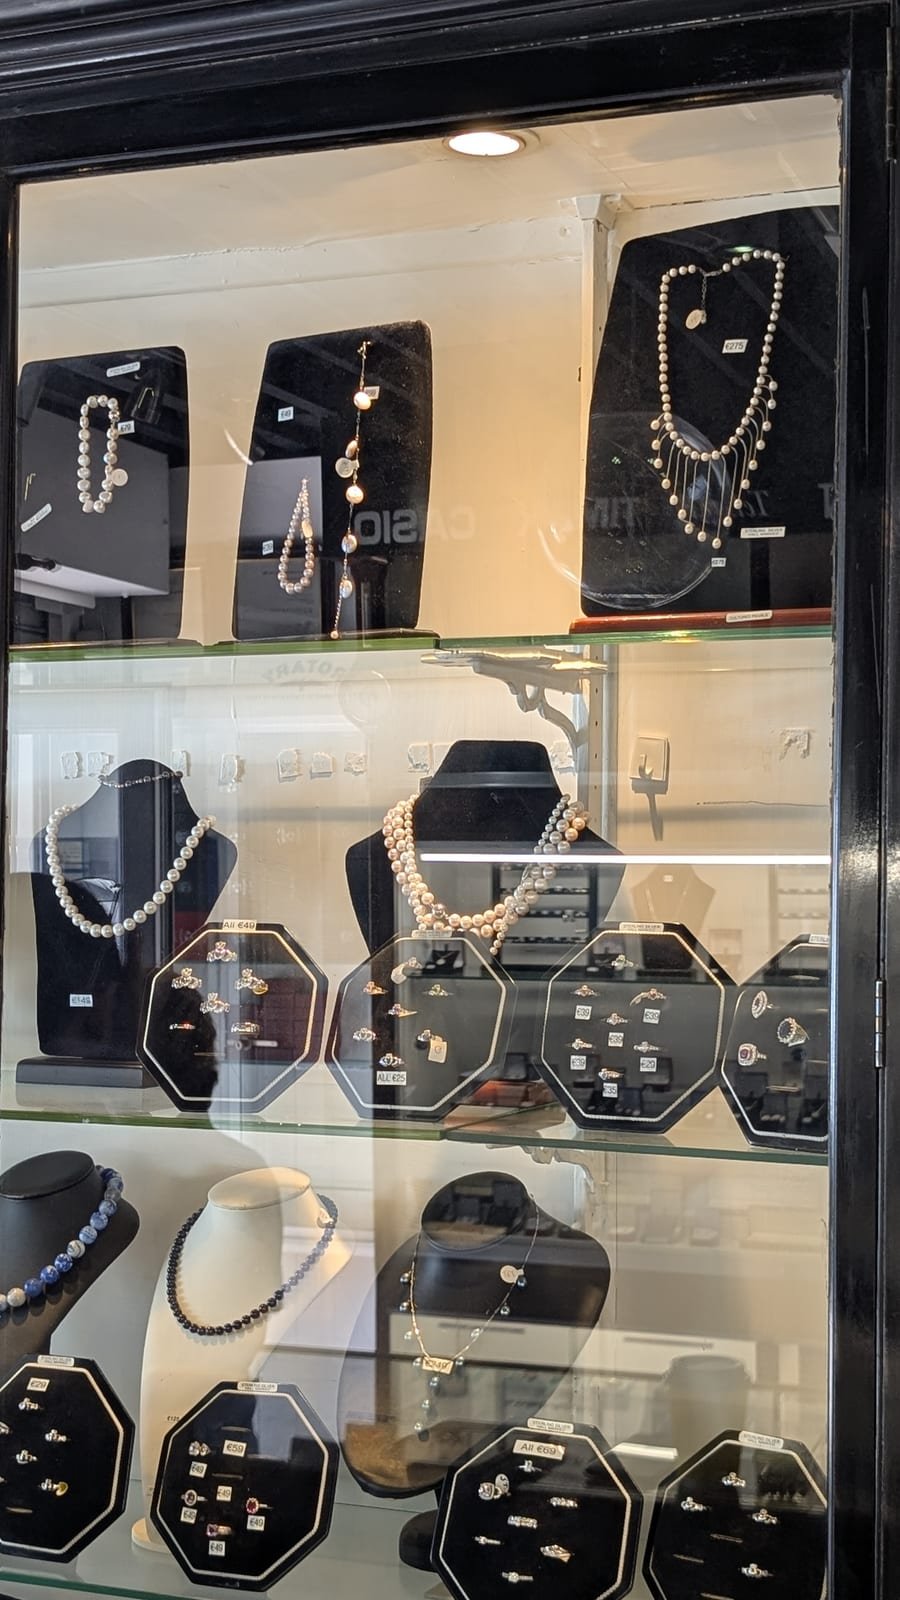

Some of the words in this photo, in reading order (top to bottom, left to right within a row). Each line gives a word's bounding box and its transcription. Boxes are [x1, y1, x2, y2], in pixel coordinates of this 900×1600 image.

[725, 342, 744, 351] €275
[226, 1443, 245, 1454] €59
[520, 1443, 535, 1452] All
[536, 1446, 557, 1456] €69
[249, 1516, 264, 1527] €49
[210, 1542, 224, 1553] €49
